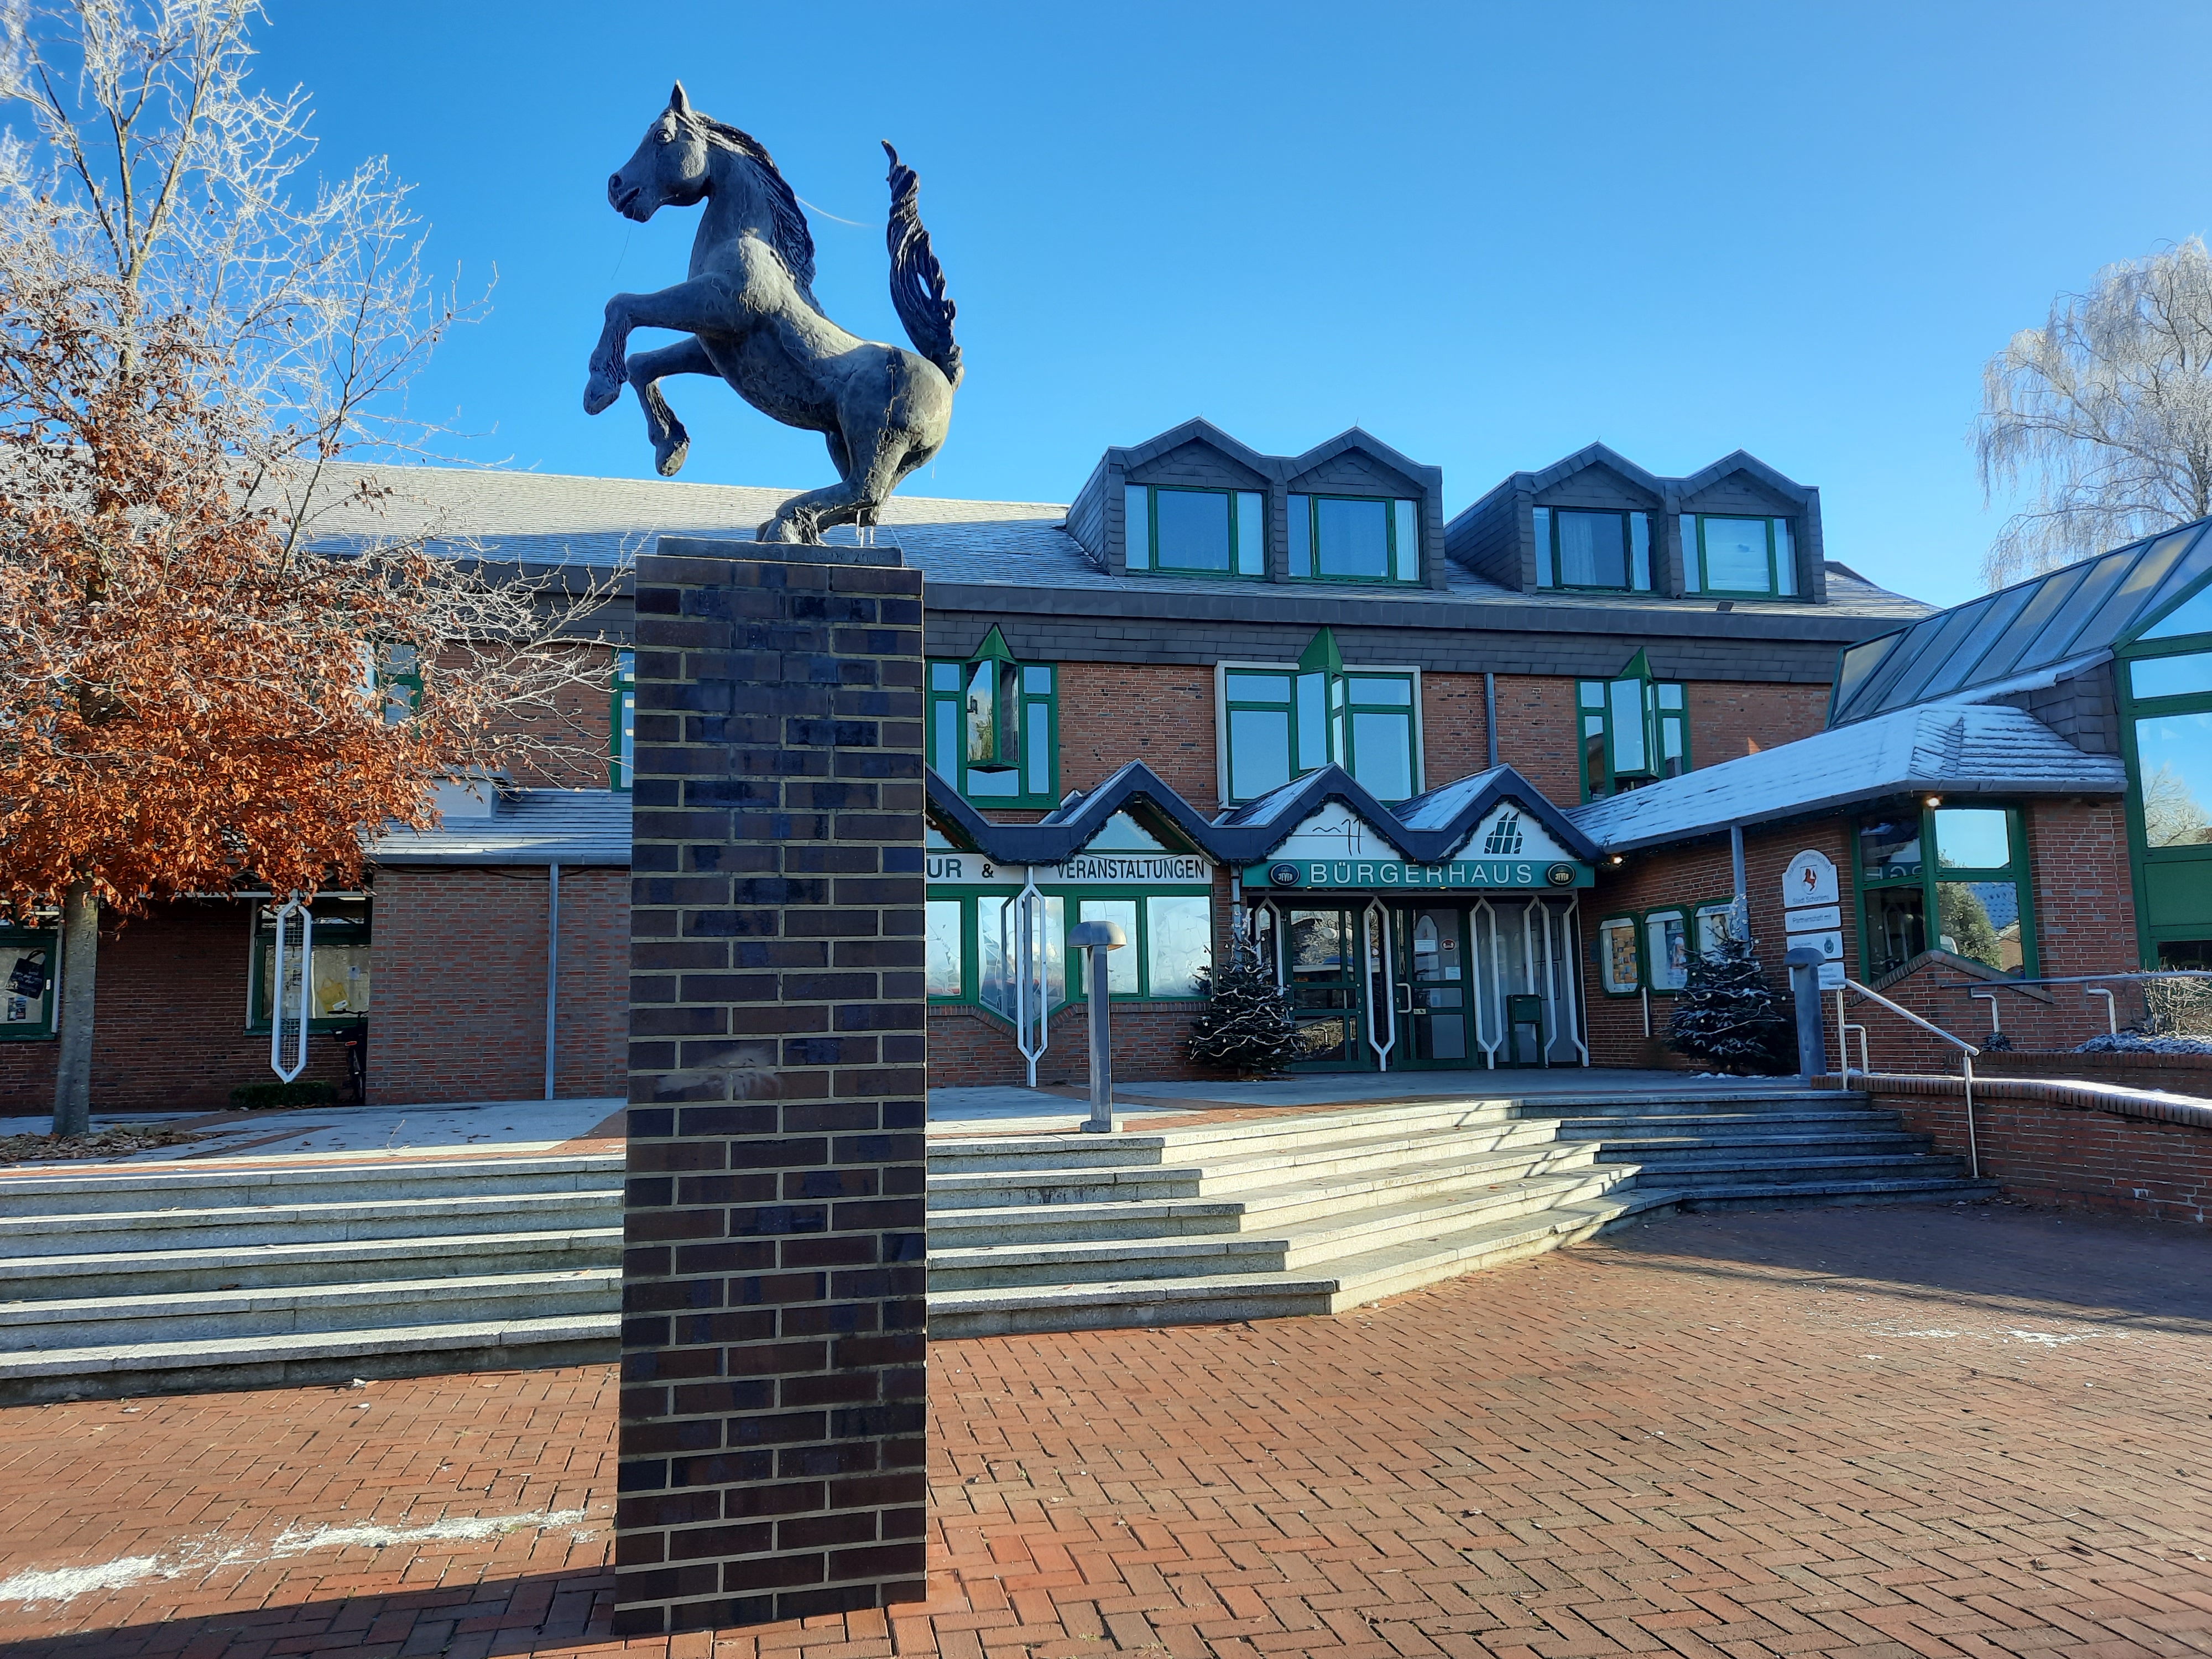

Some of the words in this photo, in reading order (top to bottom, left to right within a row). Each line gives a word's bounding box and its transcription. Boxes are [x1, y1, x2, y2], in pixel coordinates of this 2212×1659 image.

[982, 863, 994, 878] &
[1057, 859, 1205, 879] VERANSTALTUNGEN
[1311, 862, 1532, 884] BÜRGERHAUS
[1554, 872, 1569, 881] JEVER
[1278, 872, 1293, 882] JEVER
